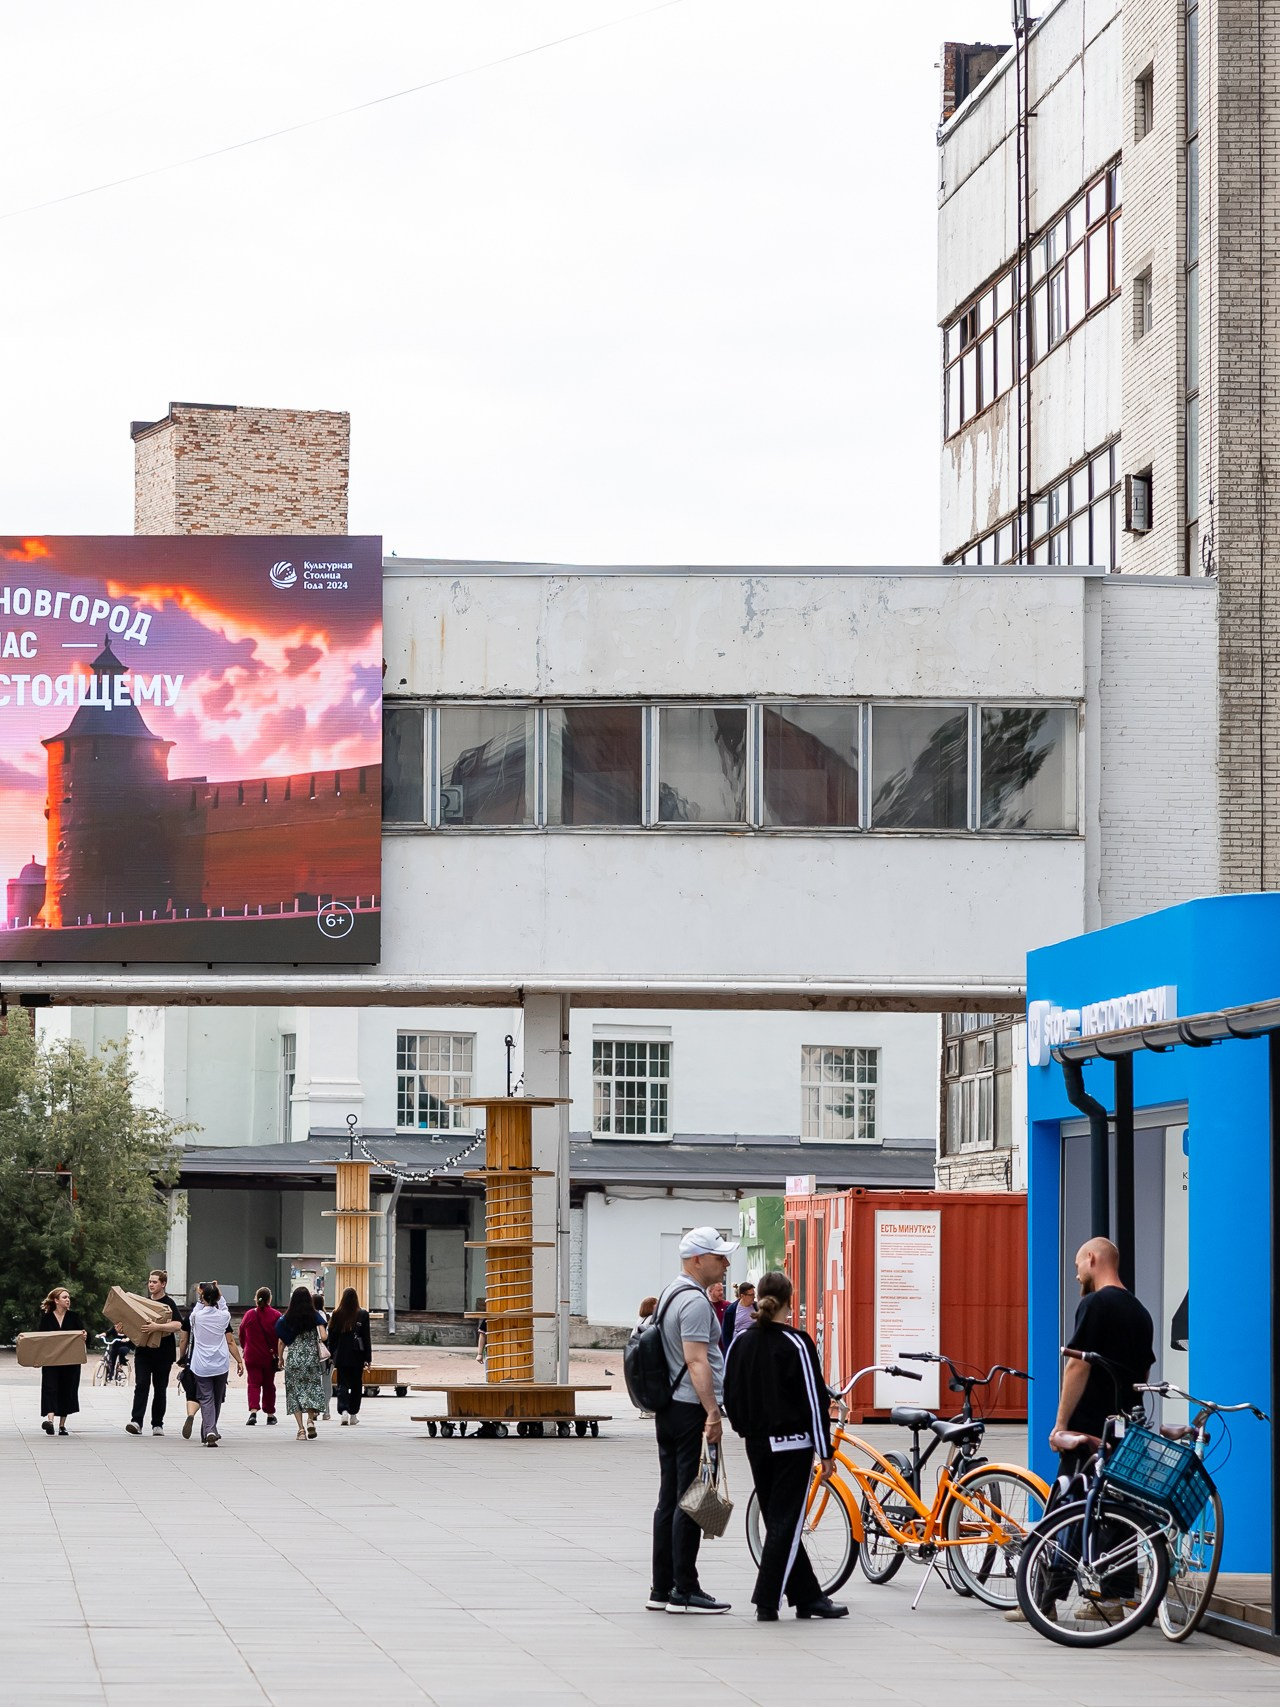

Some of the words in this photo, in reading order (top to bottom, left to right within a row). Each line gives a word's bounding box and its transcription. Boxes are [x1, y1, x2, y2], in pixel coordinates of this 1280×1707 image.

[303, 561, 353, 572] Культурная
[303, 570, 341, 580] Столица
[303, 581, 324, 590] Года
[326, 581, 349, 590] 2024
[325, 913, 346, 927] 6+
[1082, 998, 1117, 1037] место
[1119, 985, 1177, 1030] встречи
[880, 1224, 898, 1233] ЕСТЬ
